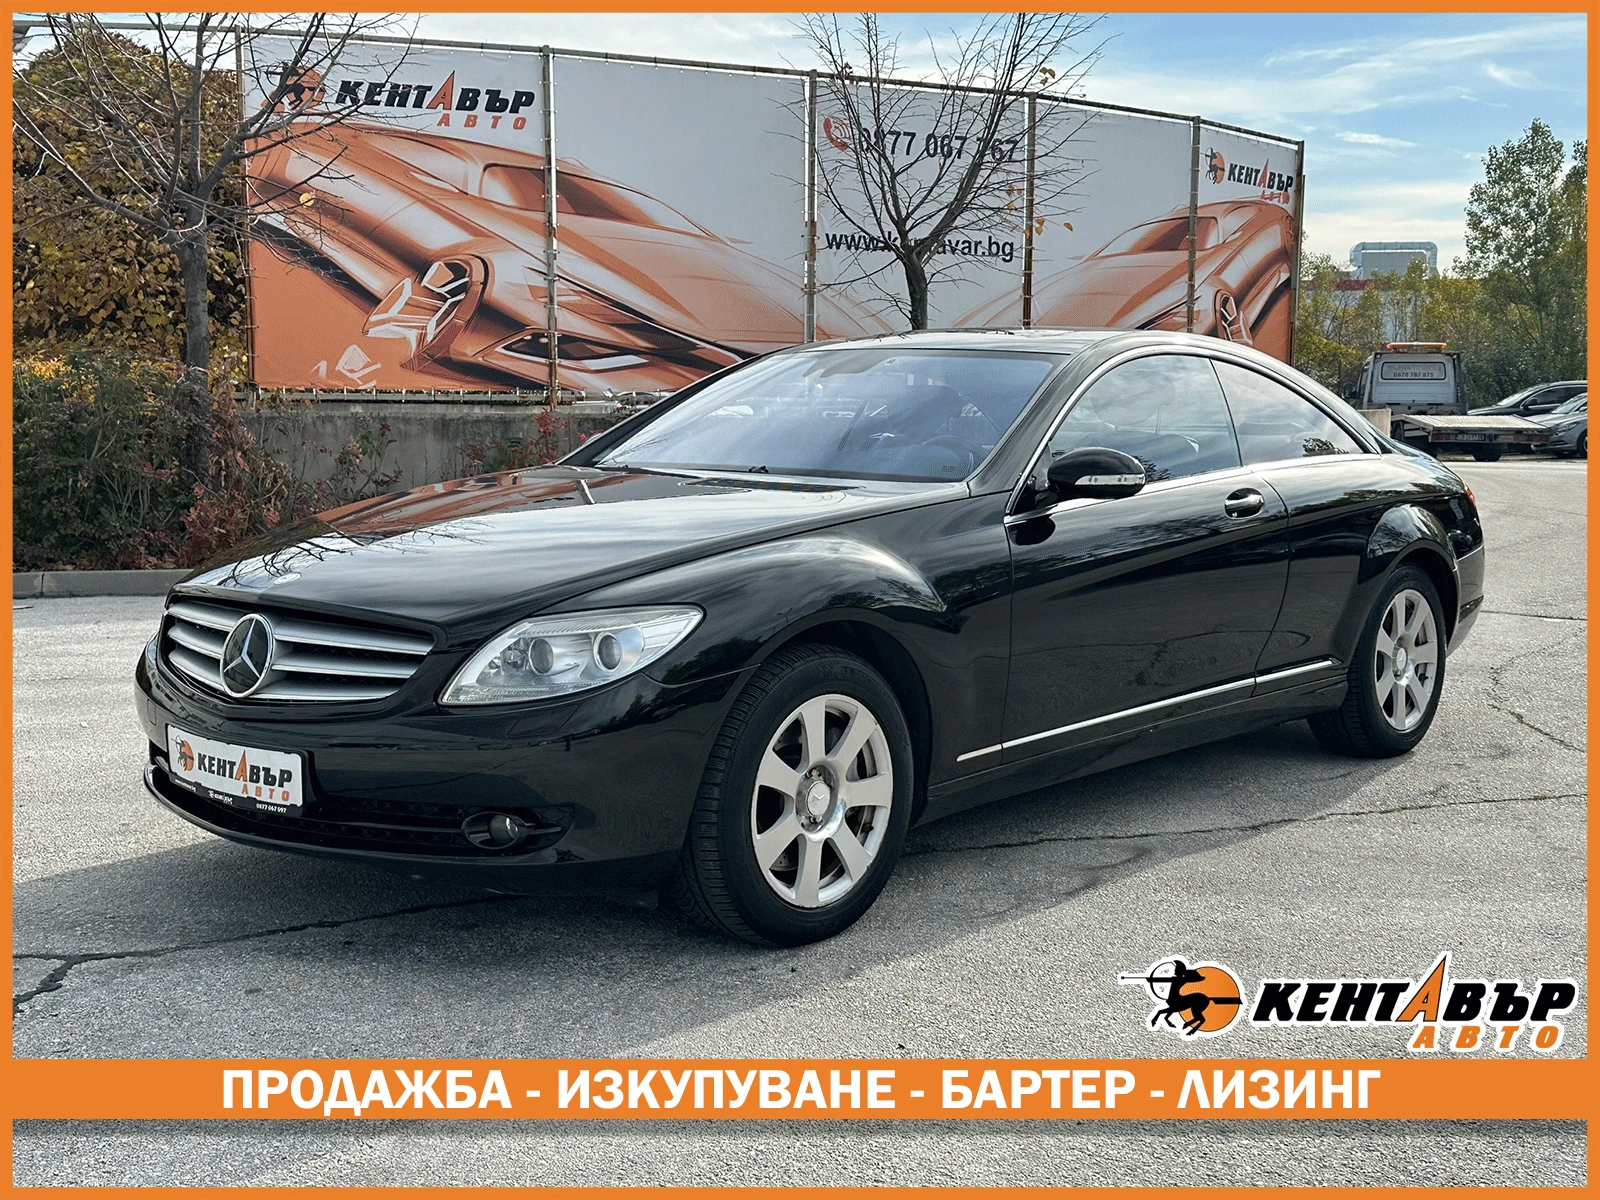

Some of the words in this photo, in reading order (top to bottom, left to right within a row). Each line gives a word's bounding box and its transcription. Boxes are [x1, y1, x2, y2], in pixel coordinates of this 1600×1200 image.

[335, 70, 535, 114] КЕНТАВЪР
[437, 113, 527, 130] АВТО
[925, 133, 967, 159] 067
[1227, 158, 1294, 192] КЕНТАВЪР
[197, 749, 293, 788] КЕНТАВЪР
[241, 783, 290, 802] АВТО
